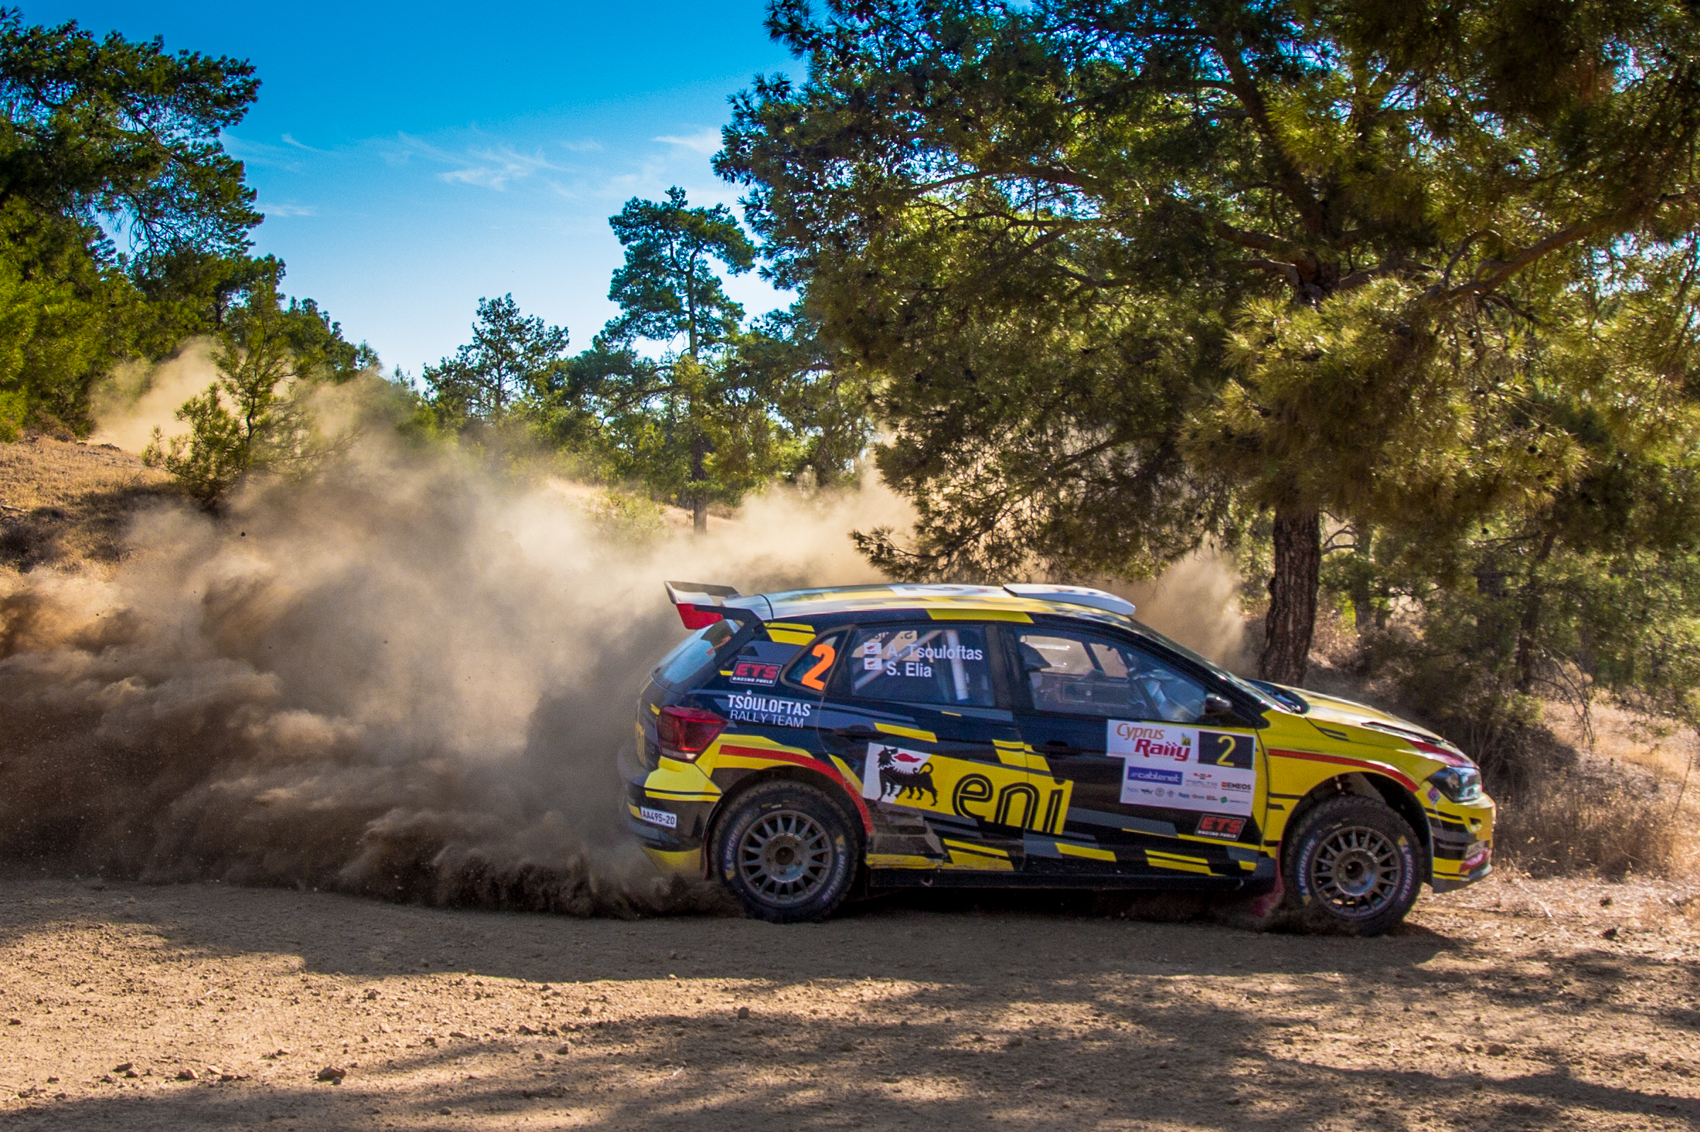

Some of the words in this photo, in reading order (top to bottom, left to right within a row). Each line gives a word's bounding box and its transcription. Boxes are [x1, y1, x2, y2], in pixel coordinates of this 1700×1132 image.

[886, 644, 902, 657] A.
[909, 643, 983, 661] Tsouloftas
[734, 663, 780, 680] ETS
[801, 643, 836, 691] 2
[886, 661, 901, 676] S.
[905, 662, 932, 678] Elia
[727, 694, 812, 717] TSOULOFTAS
[729, 709, 769, 724] RALLY
[771, 713, 805, 729] TEAM
[1116, 722, 1166, 741] Cyprus
[1216, 735, 1237, 767] 2
[1227, 781, 1252, 790] ENEOS
[952, 772, 1066, 834] eni
[642, 809, 676, 825] AA495-20
[1200, 816, 1243, 834] ETS
